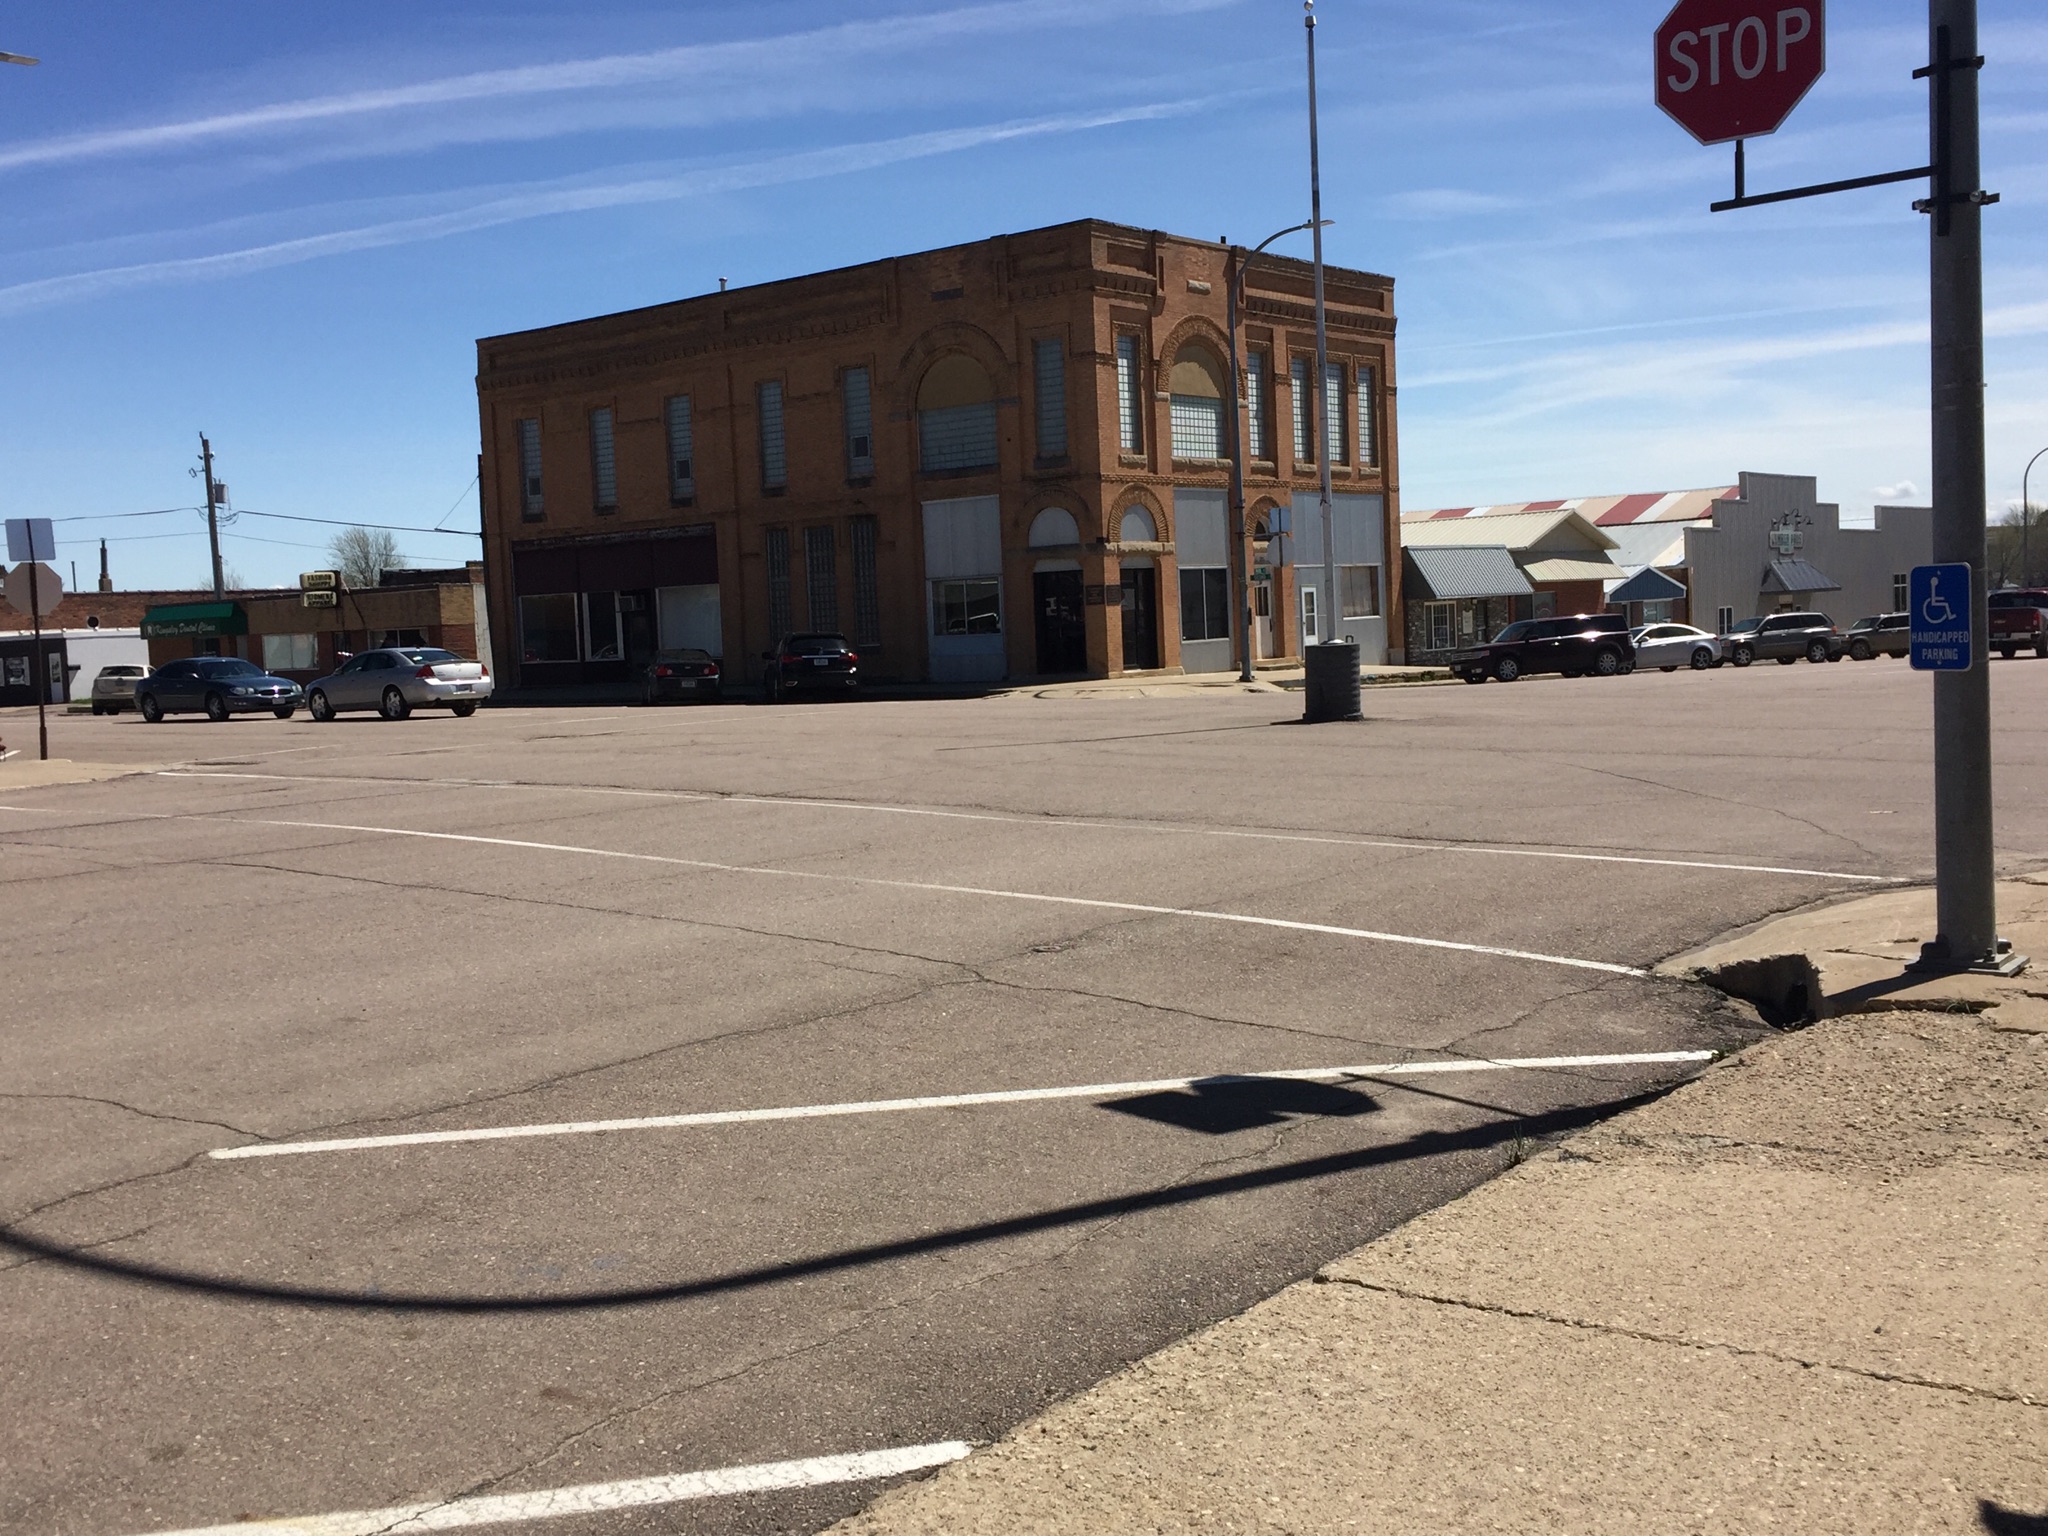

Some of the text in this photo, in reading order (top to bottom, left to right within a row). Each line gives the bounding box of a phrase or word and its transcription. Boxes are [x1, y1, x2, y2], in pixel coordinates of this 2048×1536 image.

[1667, 7, 1811, 93] STOP
[179, 622, 197, 633] Dental
[1911, 631, 1969, 643] HANDICAPPED
[1922, 648, 1958, 660] PARKING
